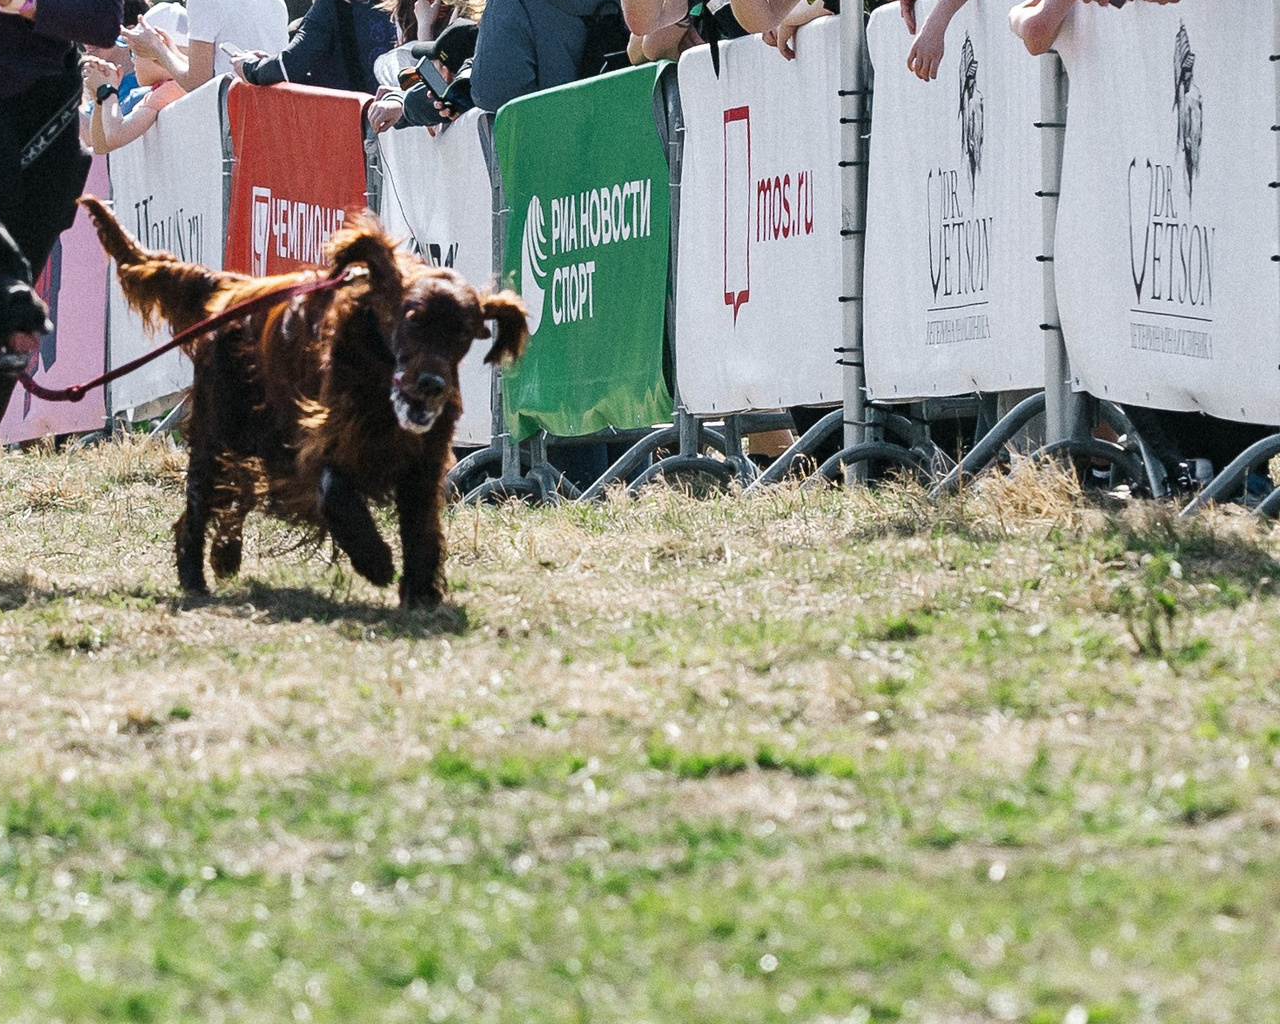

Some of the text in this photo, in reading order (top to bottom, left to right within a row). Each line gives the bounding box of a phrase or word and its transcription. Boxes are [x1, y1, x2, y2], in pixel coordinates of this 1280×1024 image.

[551, 179, 651, 255] РИА НОВОСТИ
[756, 170, 814, 242] mos.ru
[927, 167, 994, 303] VETSON
[1128, 157, 1215, 306] VETSON
[551, 261, 595, 325] СПОРТ
